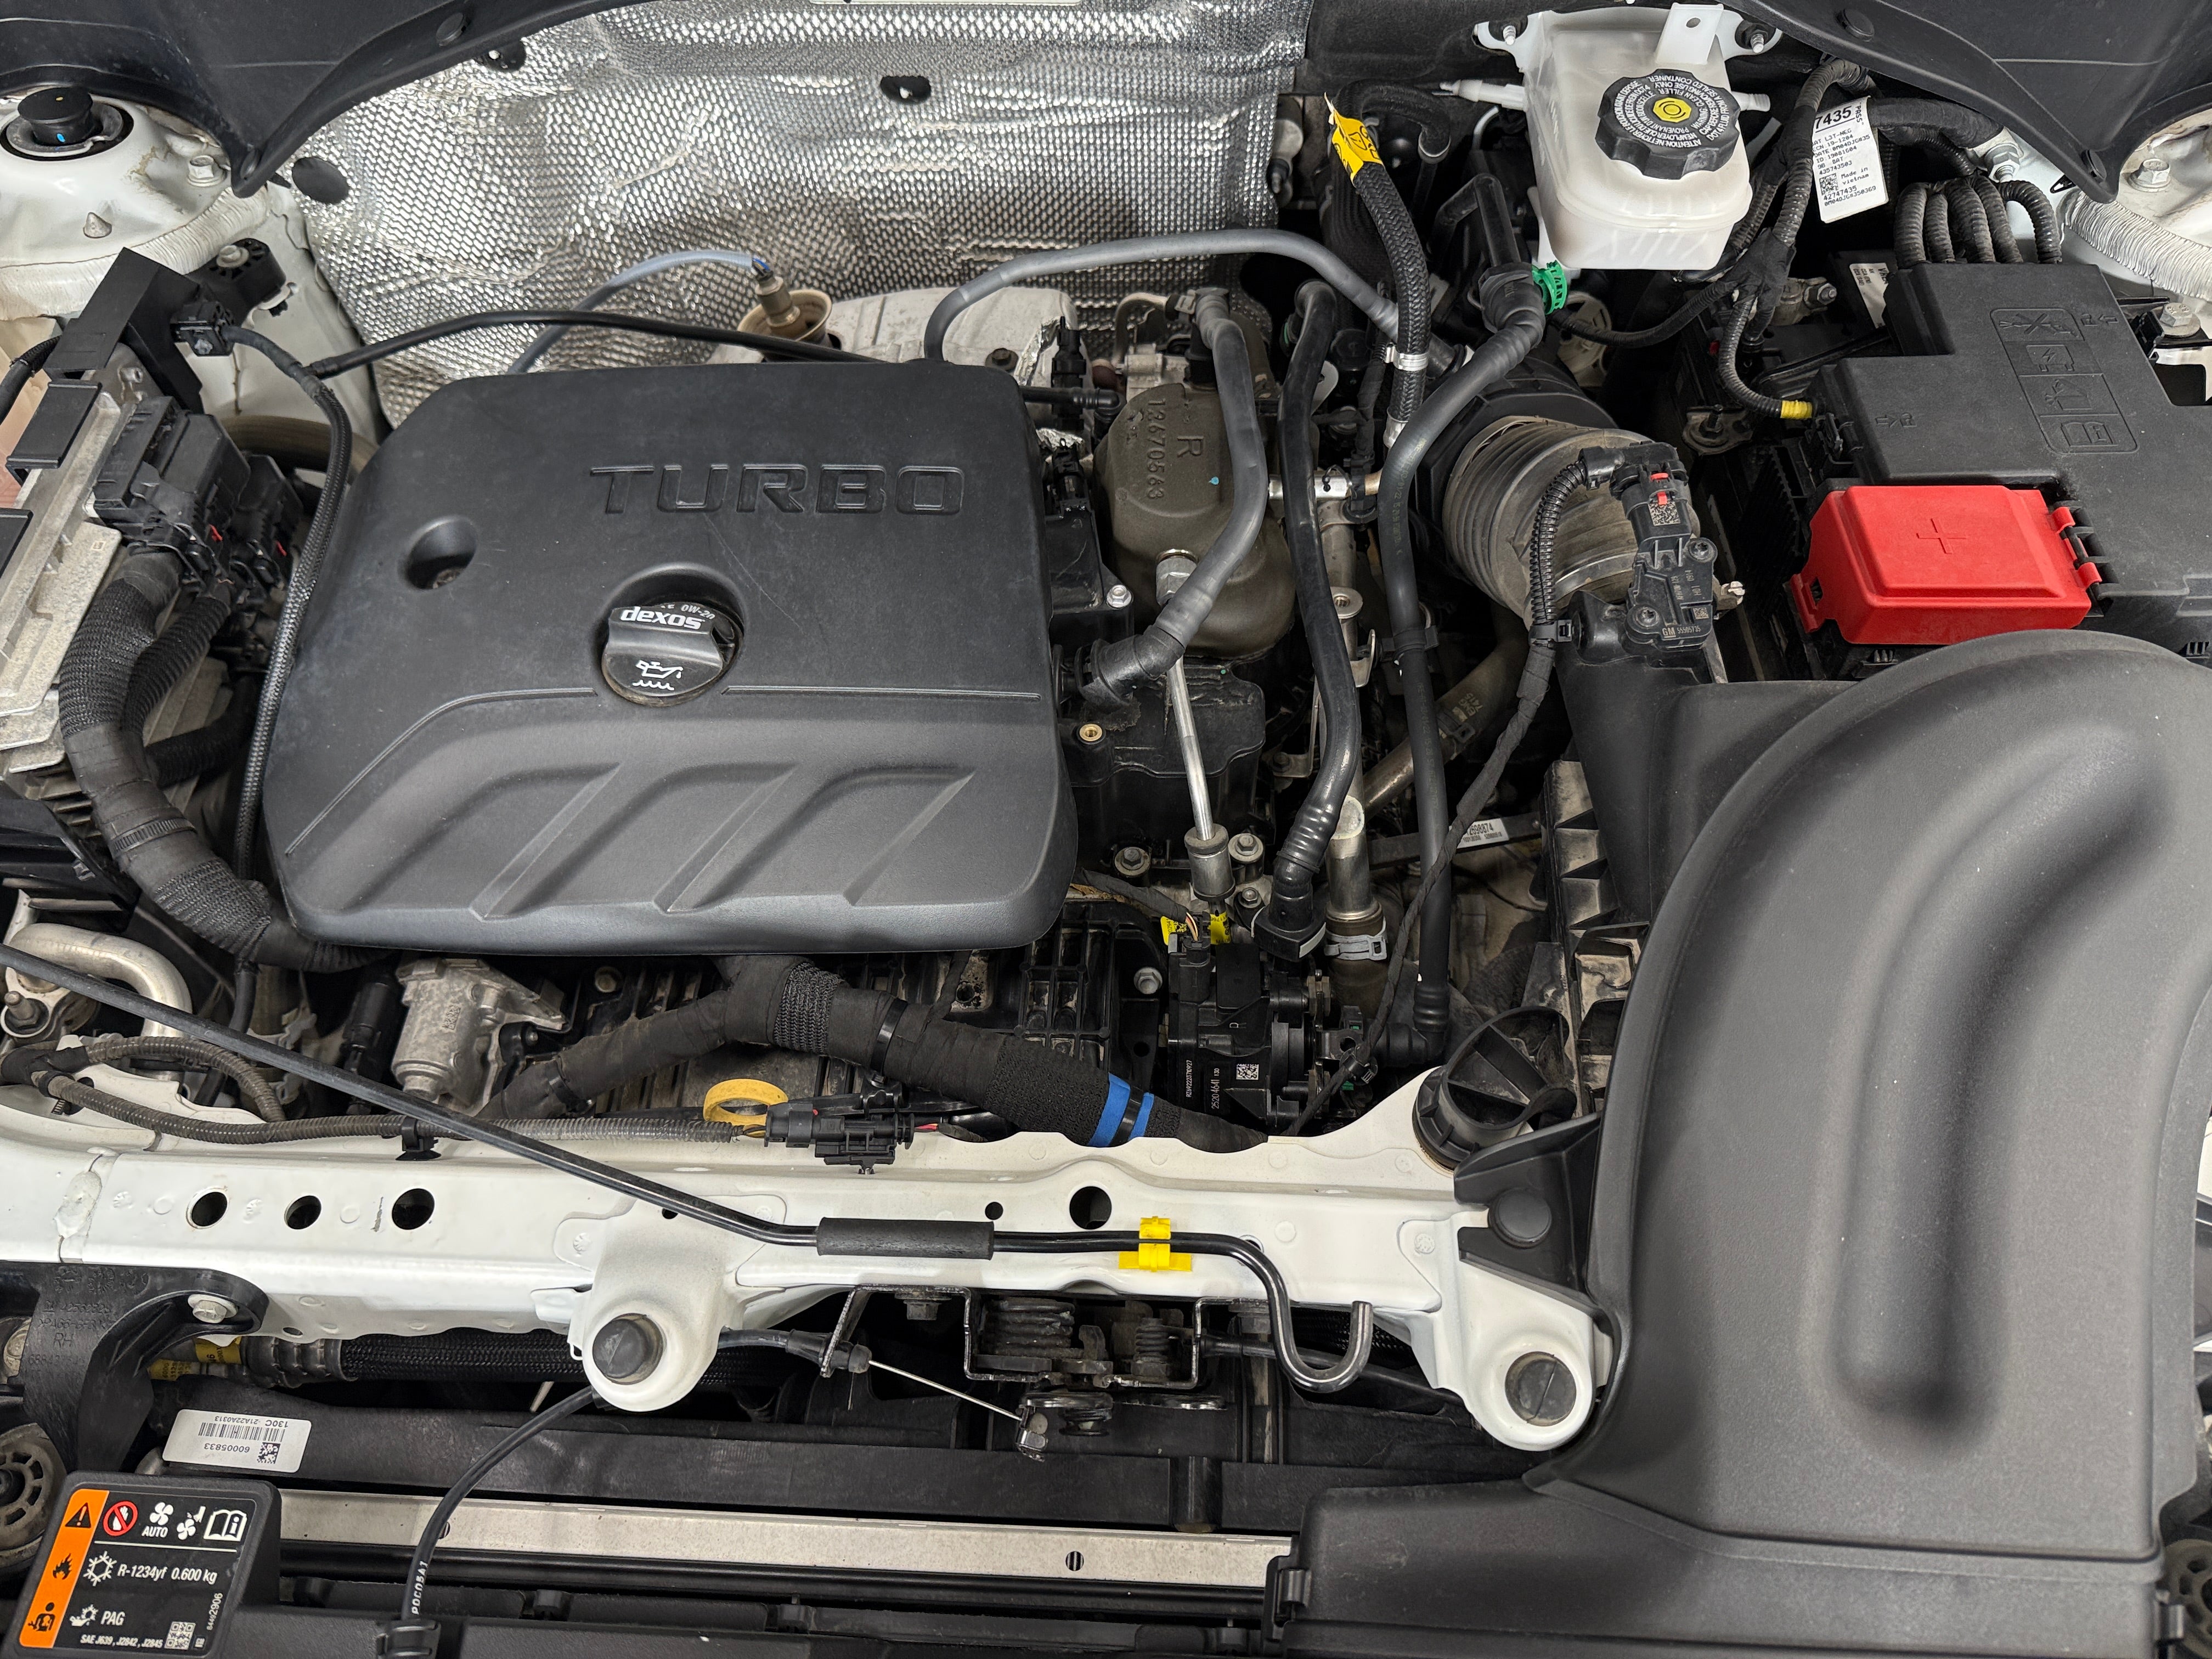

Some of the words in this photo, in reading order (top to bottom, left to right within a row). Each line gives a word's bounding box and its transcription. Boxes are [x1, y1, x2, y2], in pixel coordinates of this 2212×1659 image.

[1691, 81, 1719, 97] SEALED
[1614, 93, 1626, 107] AVANT
[1683, 92, 1704, 106] CLEAN
[1717, 99, 1728, 114] FROM
[1616, 108, 1630, 127] BOUCHON
[1698, 125, 1713, 134] CAP
[1706, 108, 1719, 126] BEFORE
[1717, 115, 1730, 128] FLUID
[1643, 127, 1658, 136] QUE
[1649, 123, 1689, 133] PROVENANT
[1706, 130, 1720, 140] DOT
[1631, 129, 1664, 145] NETTOYER
[1819, 160, 1853, 174] 435743503
[1841, 171, 1857, 179] Made
[1842, 173, 1869, 185] vietnam
[1824, 185, 1857, 201] 42747435
[1177, 435, 1204, 459] R
[590, 463, 964, 515] TURBO
[620, 606, 702, 630] dexos
[1662, 627, 1677, 638] GM
[265, 1419, 289, 1428] 130C
[204, 1442, 250, 1453] 60005833
[142, 1526, 168, 1538] AUTO
[117, 1564, 167, 1582] R-1234yf
[171, 1567, 201, 1581] 0.600
[202, 1569, 218, 1584] kg
[100, 1611, 126, 1626] PAG
[80, 1634, 96, 1644] SAE
[141, 1638, 163, 1649] J2845
